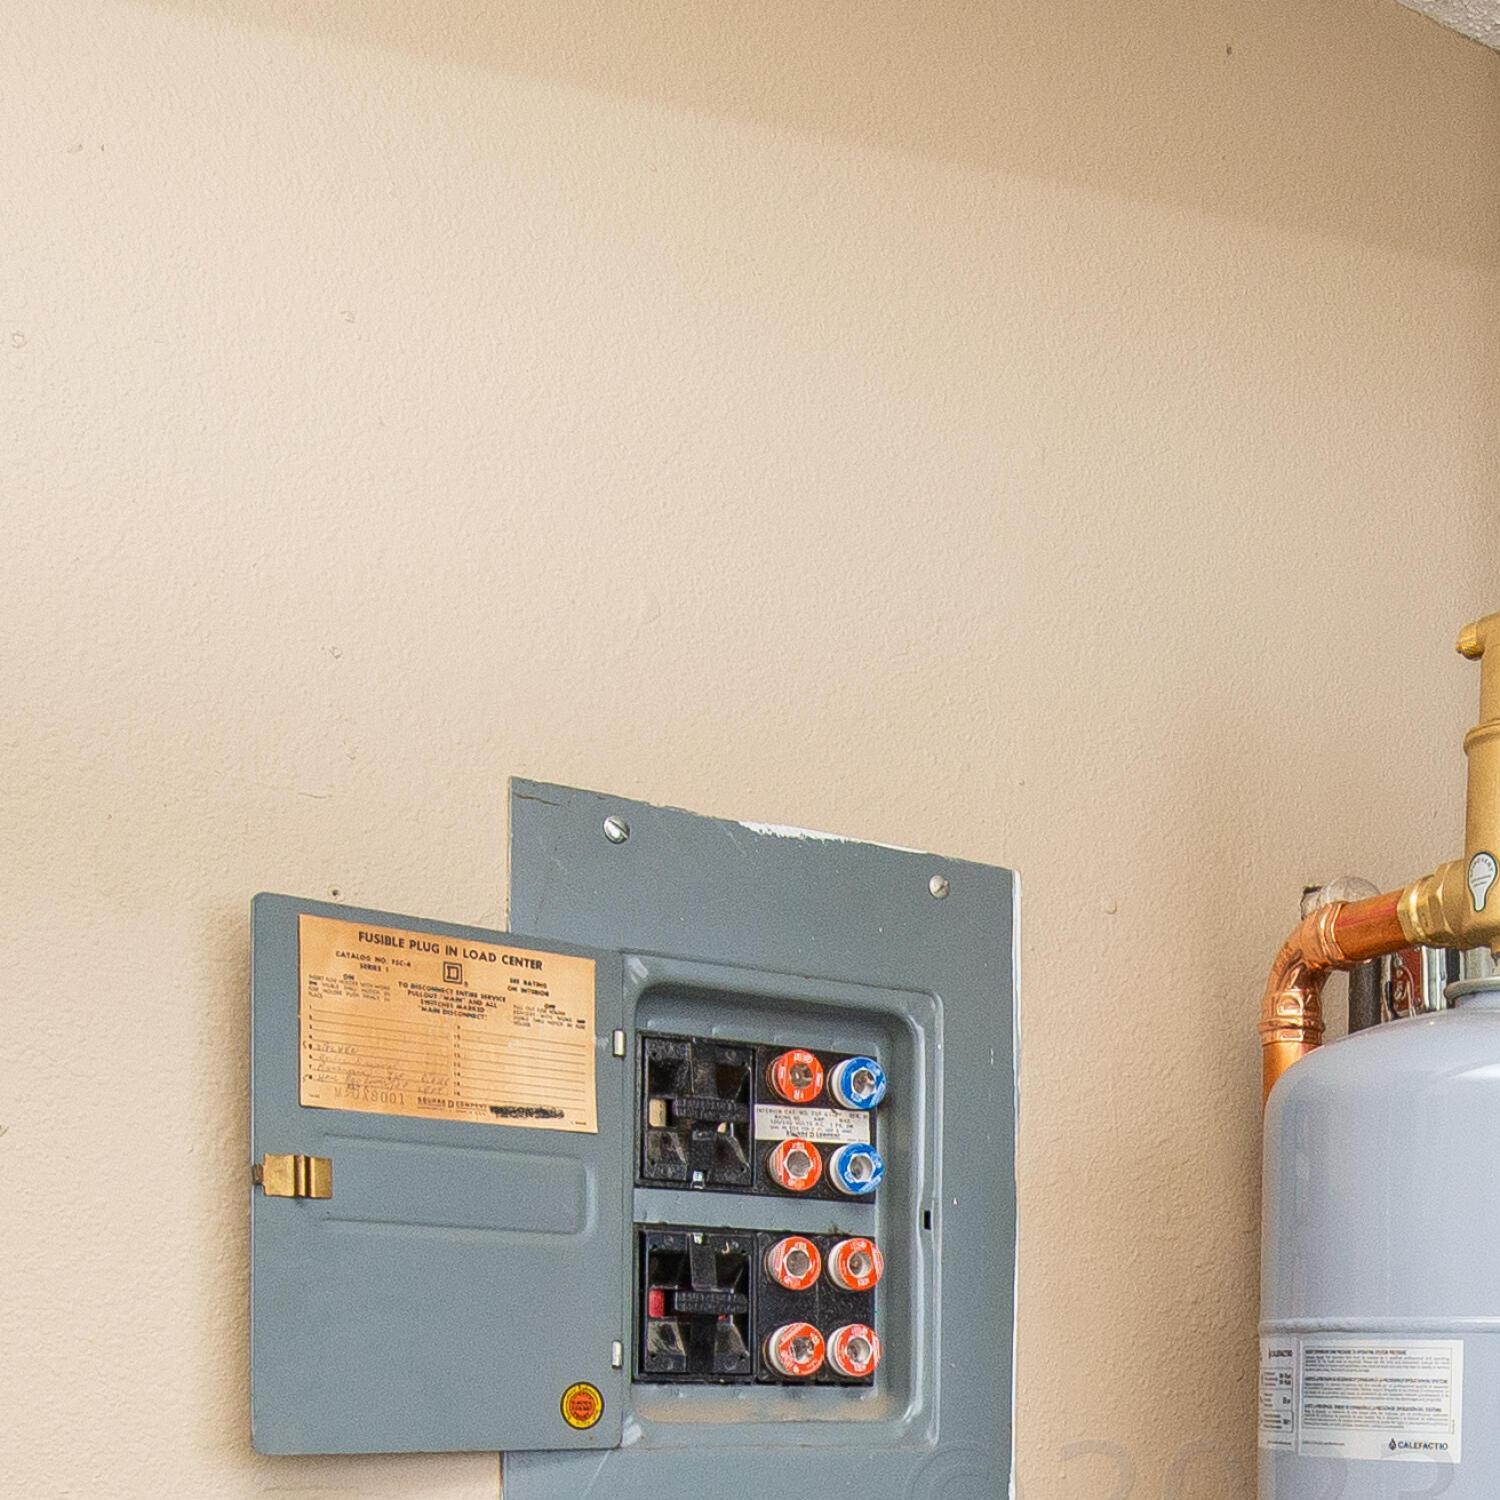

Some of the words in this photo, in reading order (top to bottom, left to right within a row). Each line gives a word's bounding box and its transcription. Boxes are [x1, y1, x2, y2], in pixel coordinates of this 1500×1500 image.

[336, 950, 370, 962] CATALOG
[358, 931, 404, 948] FUSIBLE
[409, 939, 439, 954] PLUG
[445, 945, 457, 957] IN
[463, 948, 496, 963] LOAD
[501, 954, 542, 970] CENTER
[359, 962, 381, 972] SERIES
[410, 982, 453, 995] DISCONNECT
[455, 989, 477, 998] ENTIRE
[480, 993, 505, 1002] SERVICE
[520, 987, 549, 997] INTERIOR
[1398, 1441, 1448, 1450] CALEFACTIO
